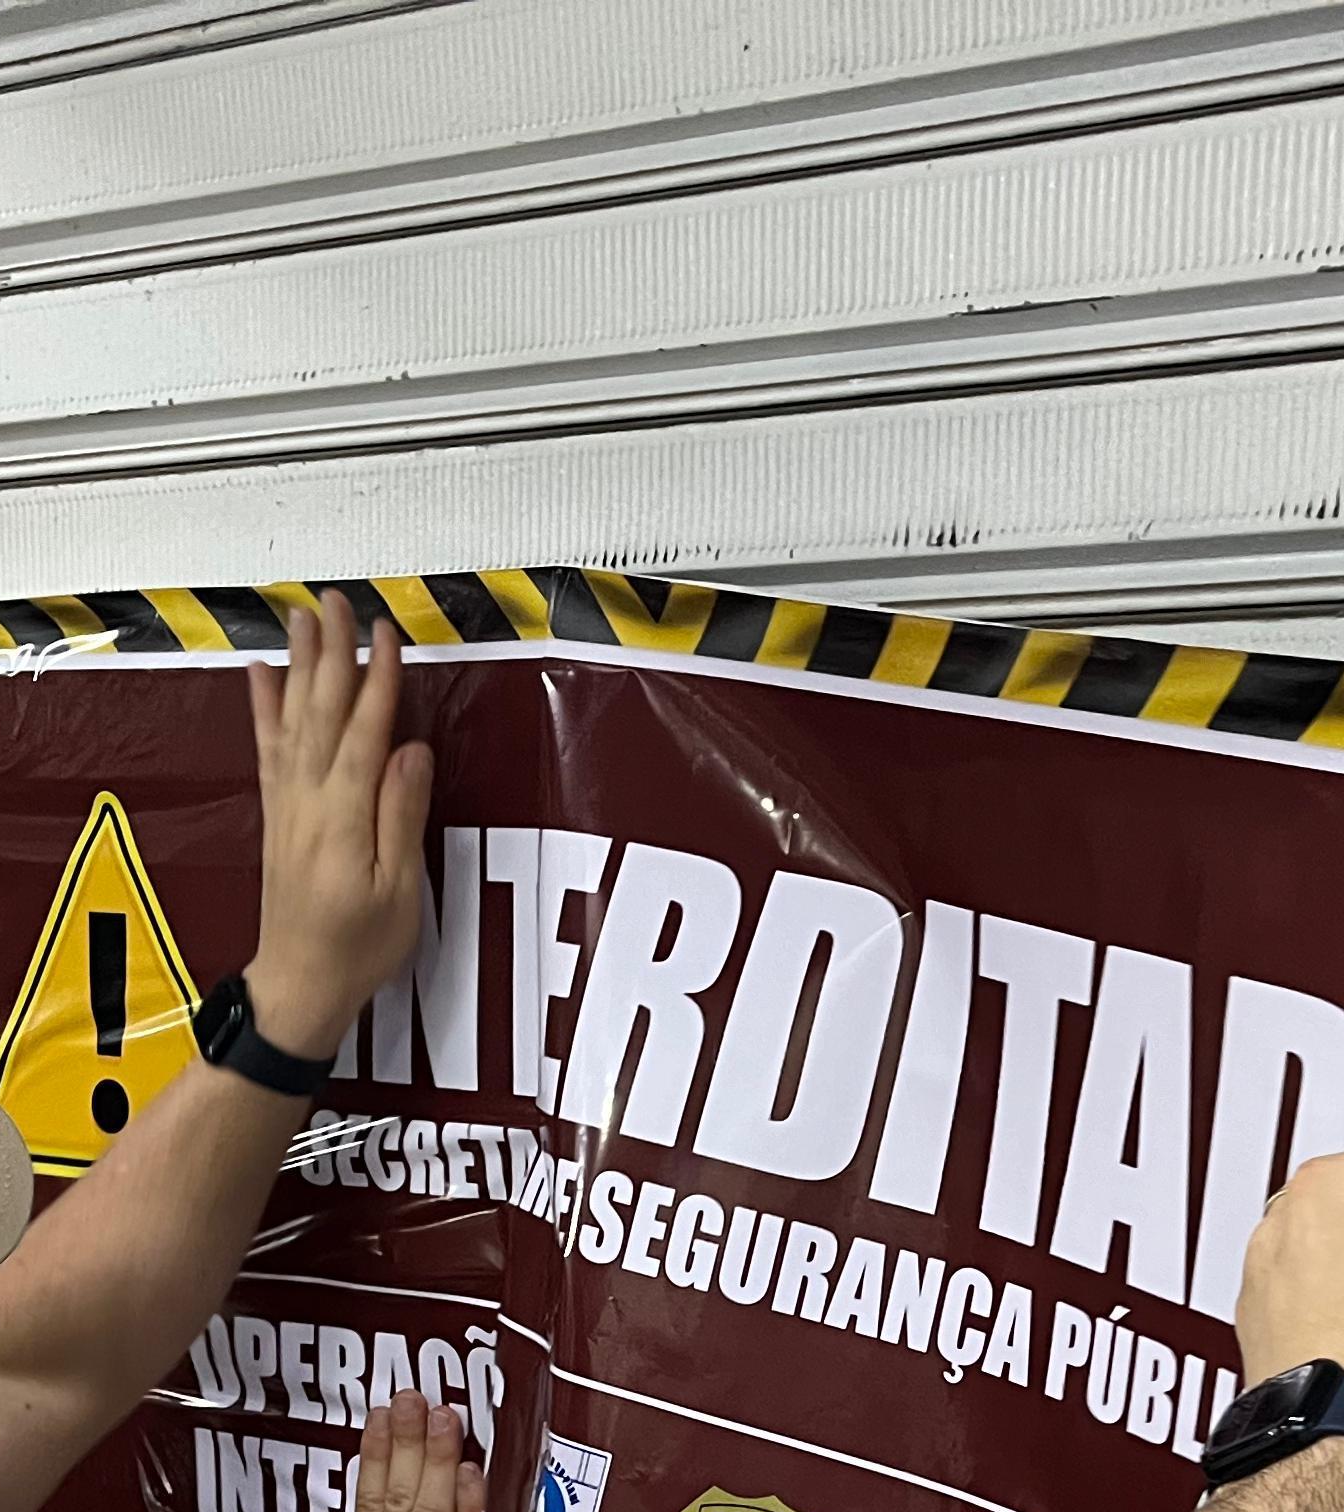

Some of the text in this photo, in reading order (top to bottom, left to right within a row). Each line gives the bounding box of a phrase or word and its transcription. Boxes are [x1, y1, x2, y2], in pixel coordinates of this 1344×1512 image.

[189, 1313, 504, 1456] OPERAÇÕ
[300, 1109, 539, 1206] SECRETA
[578, 1170, 1033, 1387] SEGURANÇA
[1044, 1301, 1238, 1464] PÚBLI
